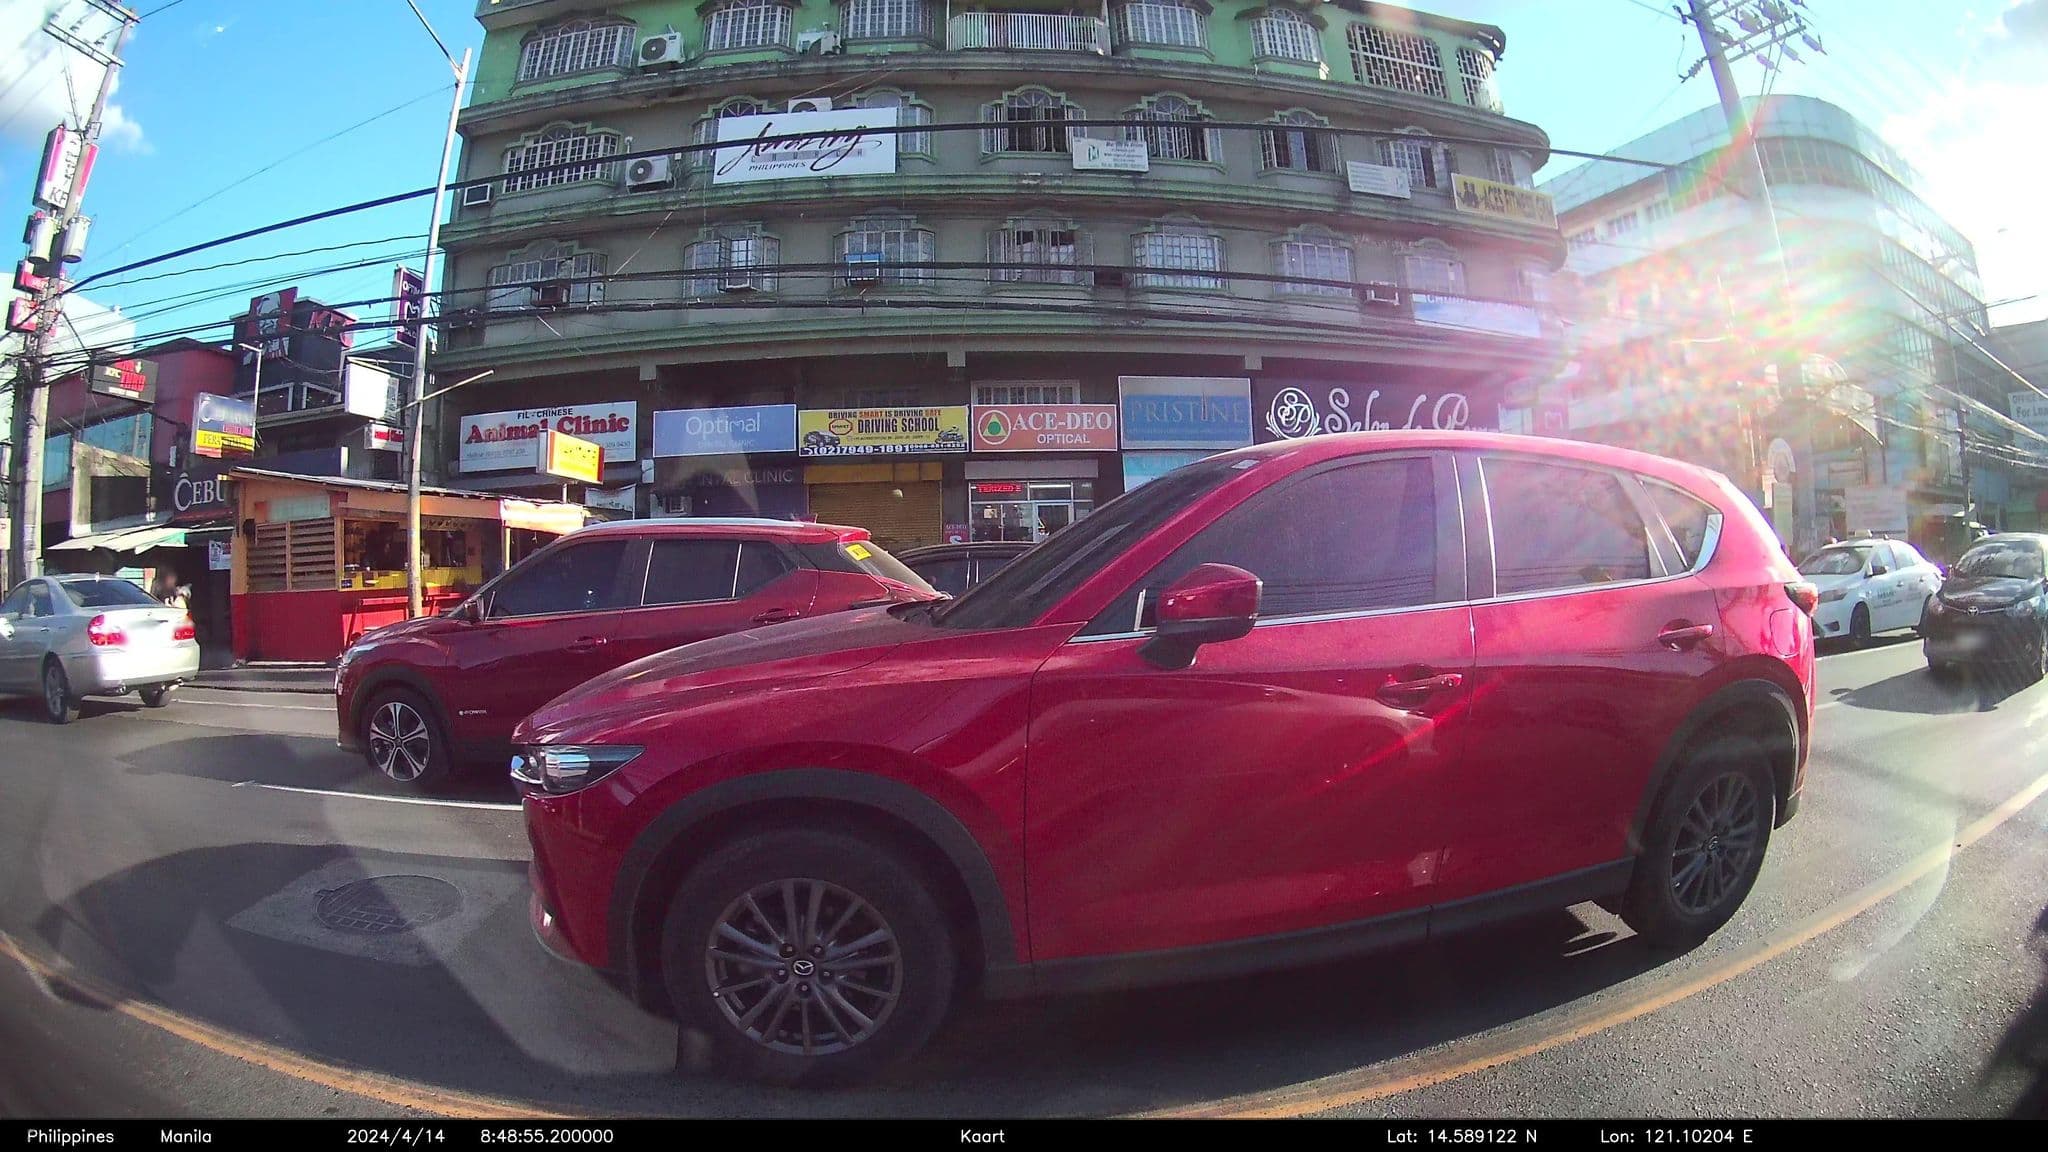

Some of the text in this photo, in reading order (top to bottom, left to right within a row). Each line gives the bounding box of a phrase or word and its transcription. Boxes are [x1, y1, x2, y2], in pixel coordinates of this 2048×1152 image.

[749, 162, 806, 172] PHILIPPINES
[828, 411, 858, 419] DRIVING
[894, 409, 924, 417] DRIVING
[1130, 398, 1244, 422] PRISTINE
[557, 413, 630, 436] Clinic
[686, 412, 760, 440] Optimal
[857, 417, 940, 434] DRIVING SCHOOL
[1012, 411, 1113, 432] ACE-DEO
[1037, 433, 1091, 444] OPTICAL
[744, 469, 793, 484] CLINIC
